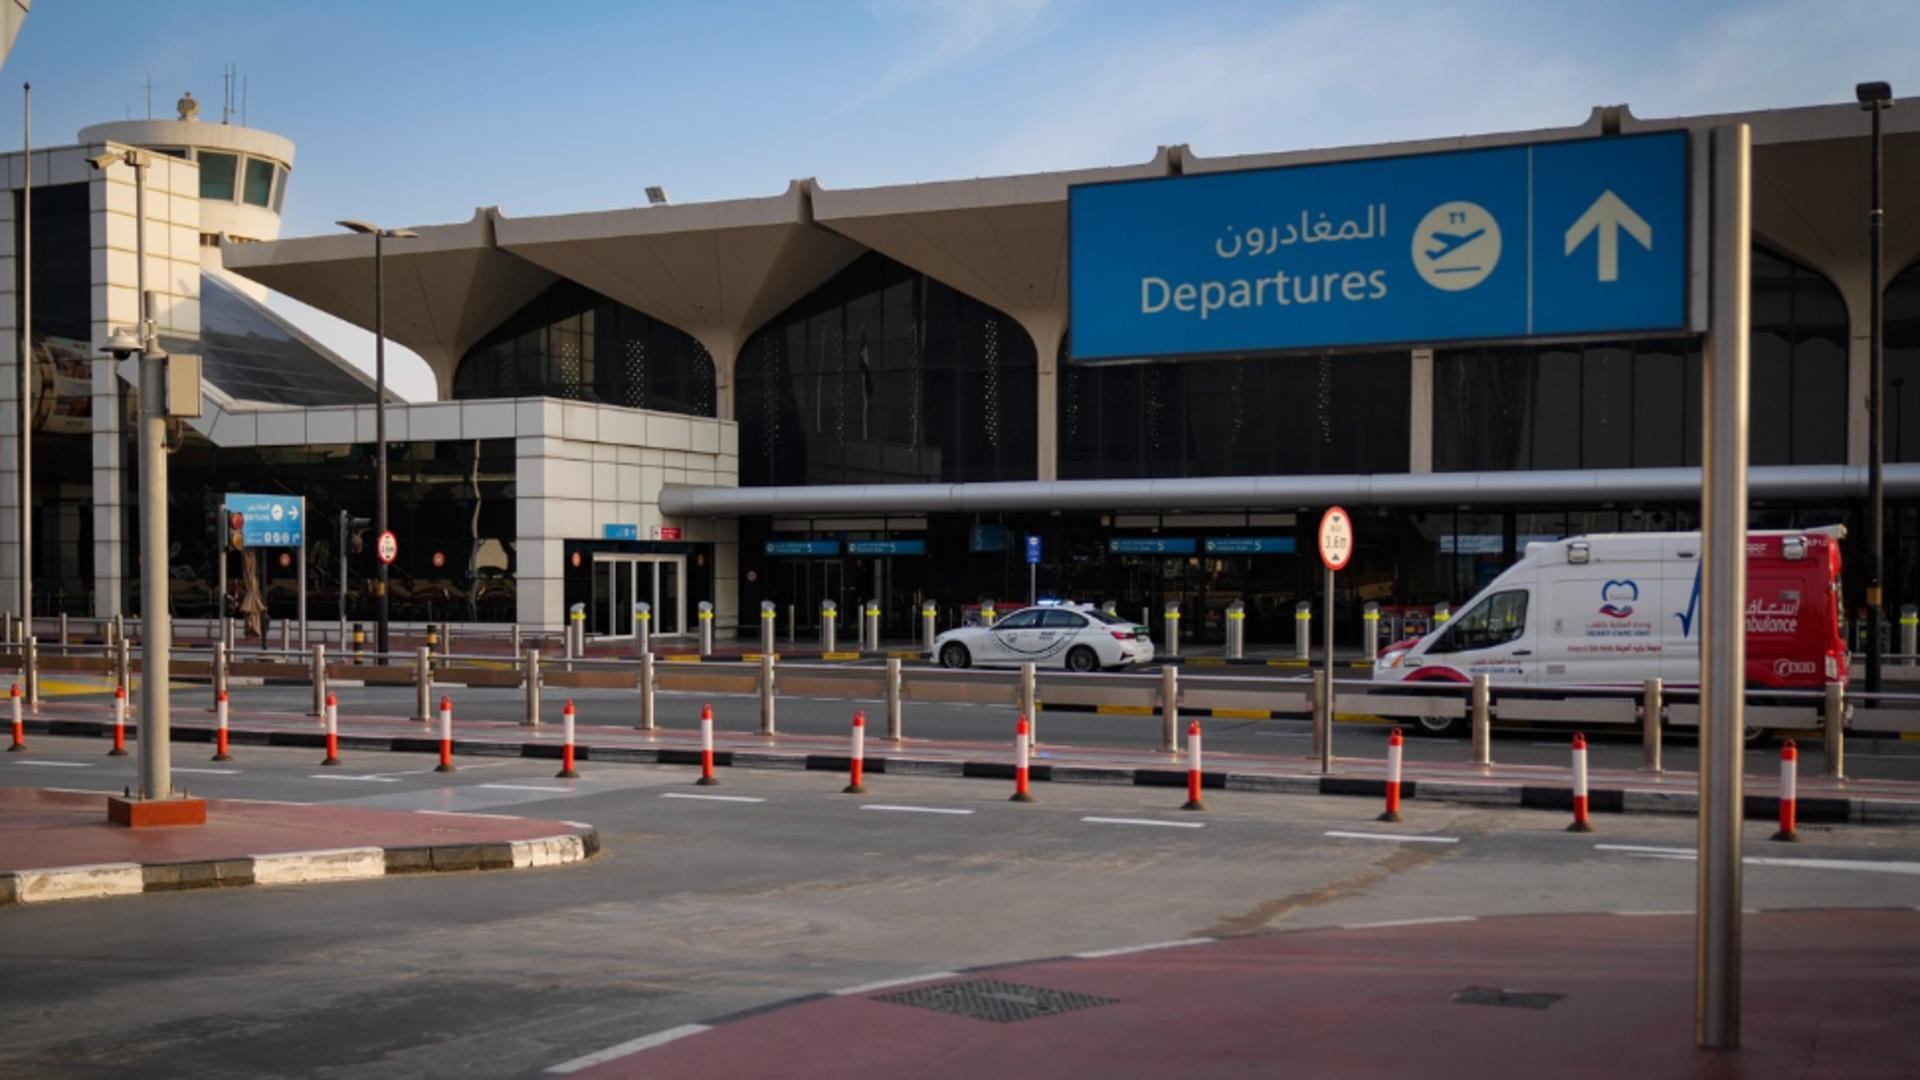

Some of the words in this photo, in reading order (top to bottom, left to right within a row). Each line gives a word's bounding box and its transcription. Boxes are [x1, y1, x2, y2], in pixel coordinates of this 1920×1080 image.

[1216, 204, 1387, 258] المغادرون
[1448, 212, 1466, 224] T1
[1141, 268, 1388, 320] Departures
